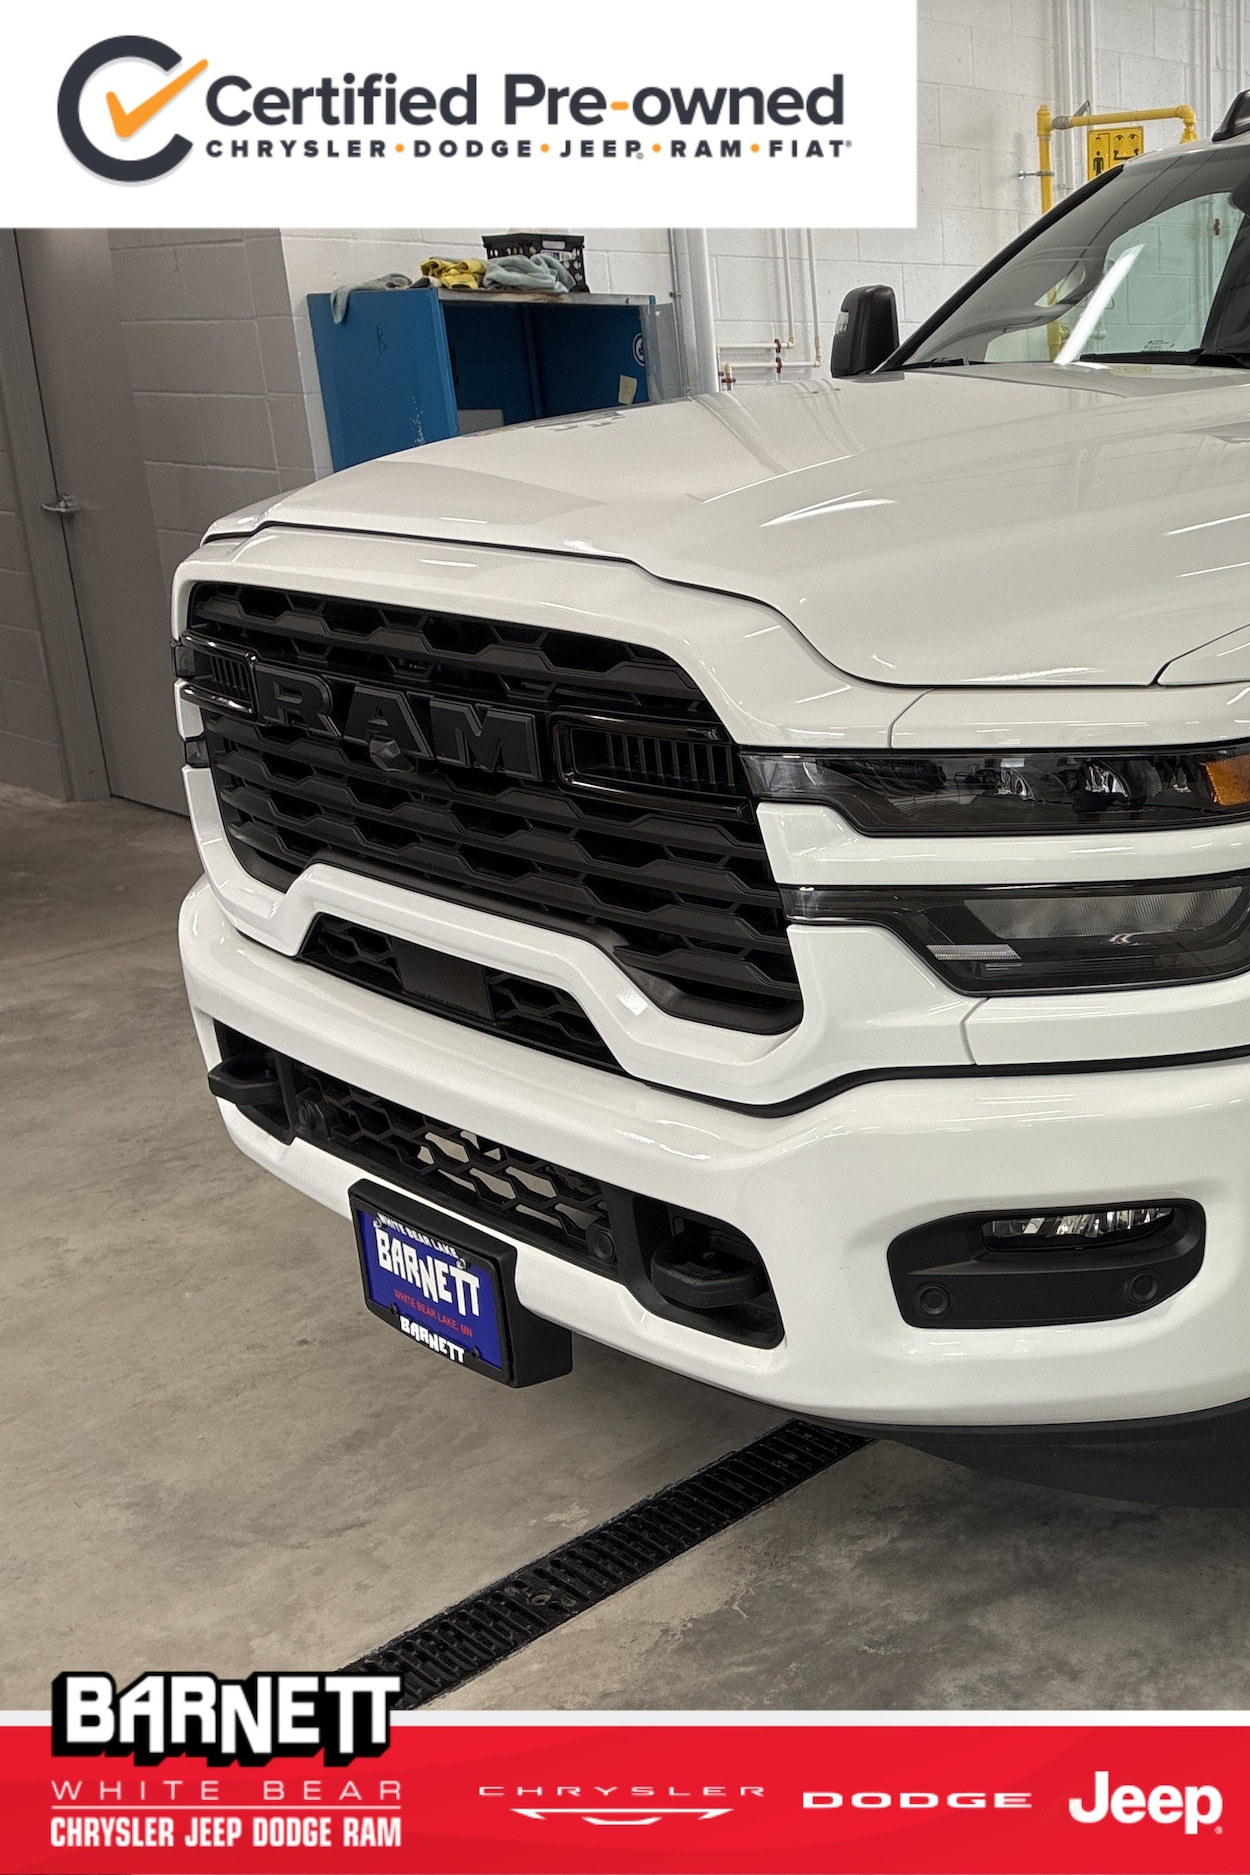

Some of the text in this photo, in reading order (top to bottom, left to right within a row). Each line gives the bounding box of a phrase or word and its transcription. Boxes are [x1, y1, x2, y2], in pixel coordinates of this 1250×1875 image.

[255, 665, 540, 780] RAM
[406, 1226, 433, 1247] BEAR
[431, 1238, 459, 1259] LAKE
[374, 1226, 480, 1316] BARNETT
[393, 1288, 416, 1308] WHITE
[416, 1303, 437, 1320] BEAR
[399, 1314, 465, 1363] BARNETT
